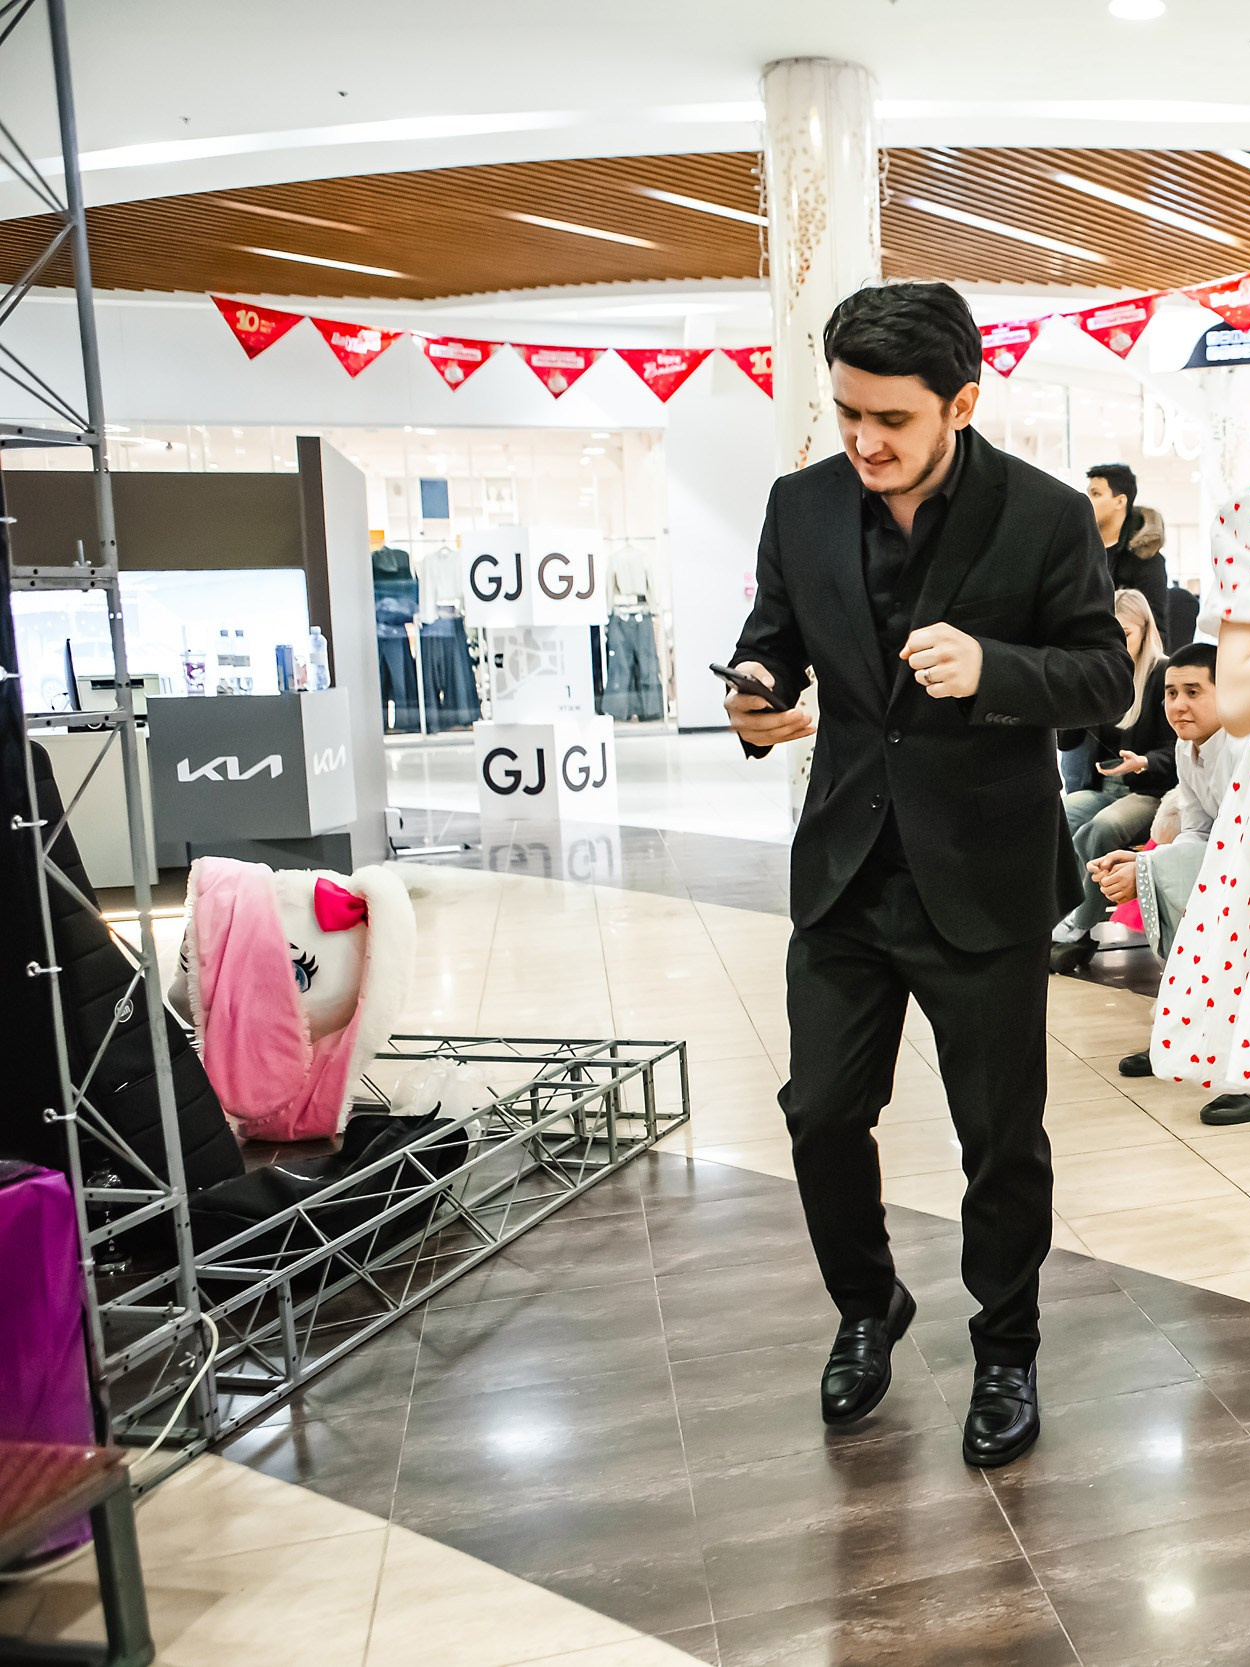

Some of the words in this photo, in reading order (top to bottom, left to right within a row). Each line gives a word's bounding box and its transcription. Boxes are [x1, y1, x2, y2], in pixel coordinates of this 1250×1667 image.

[236, 309, 260, 333] 10
[470, 553, 523, 602] GJ
[537, 552, 595, 600] GJ
[482, 747, 546, 796] GJ
[562, 742, 608, 792] GJ
